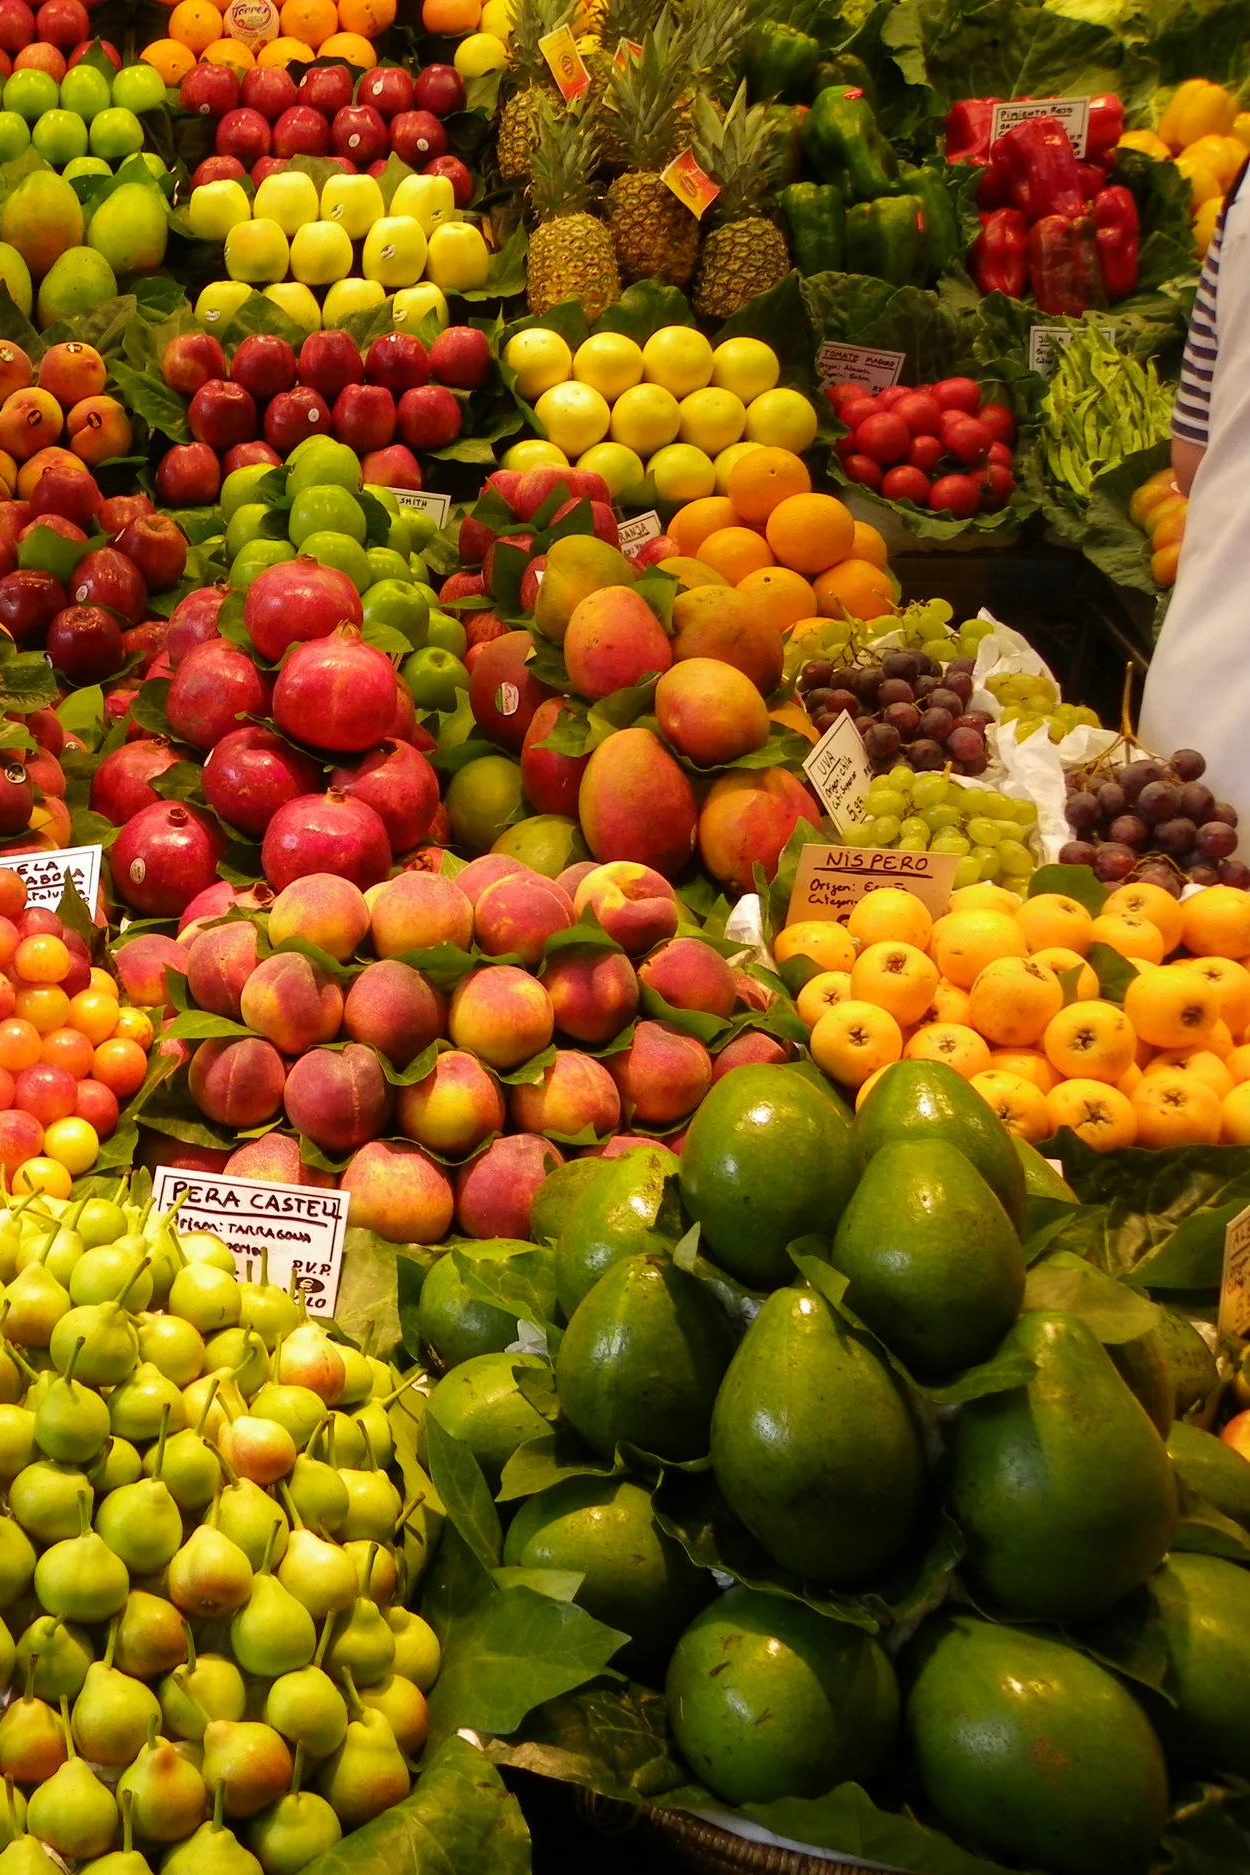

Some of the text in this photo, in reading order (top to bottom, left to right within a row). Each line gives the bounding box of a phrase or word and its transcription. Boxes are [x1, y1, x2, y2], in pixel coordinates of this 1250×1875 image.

[398, 497, 428, 508] SMITH
[620, 522, 648, 543] RANJA
[817, 750, 836, 776] UVA
[172, 1180, 241, 1208] PERA
